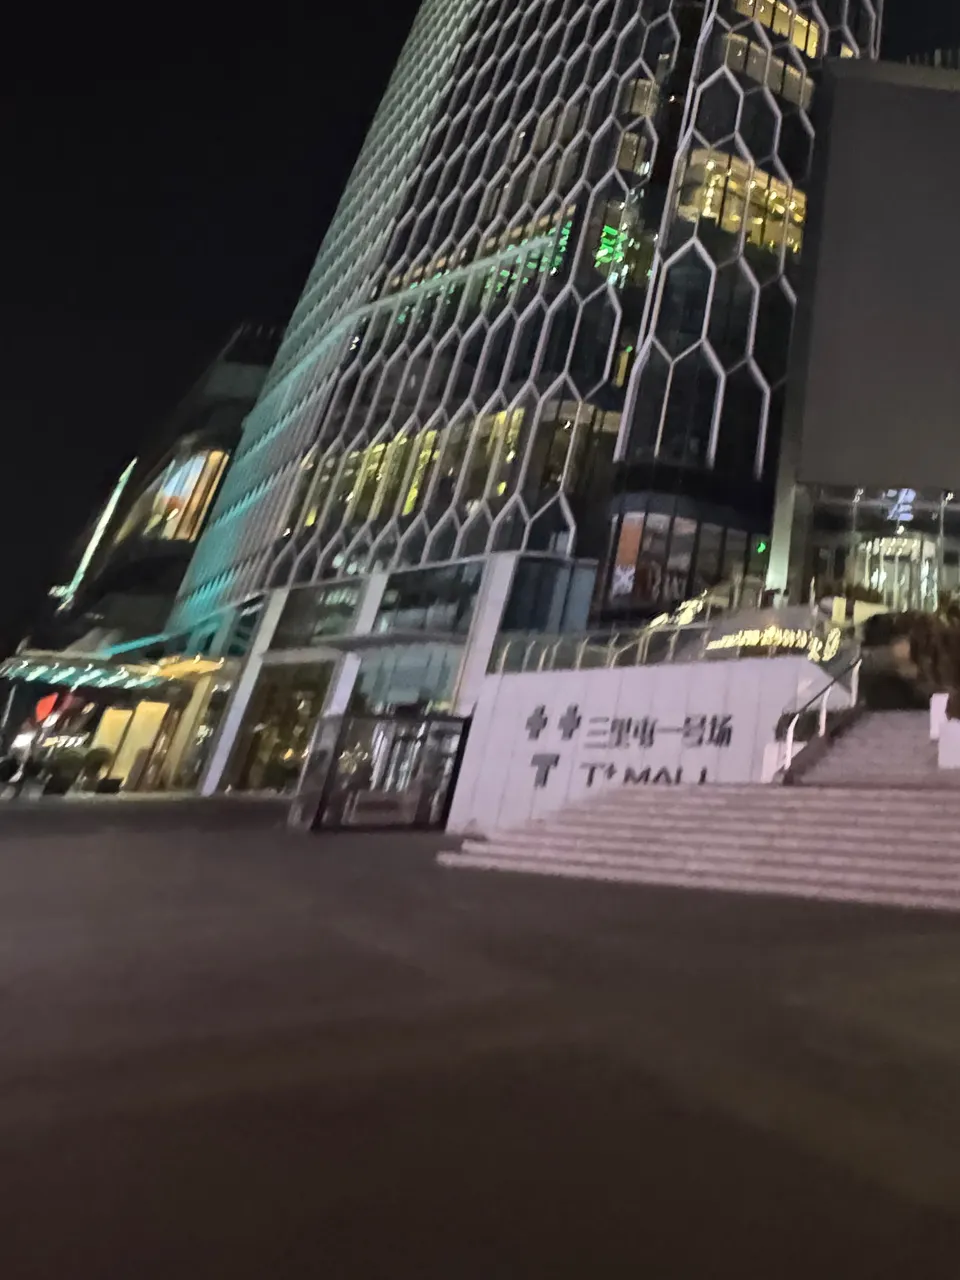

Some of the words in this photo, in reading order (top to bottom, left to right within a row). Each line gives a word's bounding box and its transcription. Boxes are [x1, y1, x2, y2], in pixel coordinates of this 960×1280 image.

[584, 714, 733, 749] 三里屯一号场
